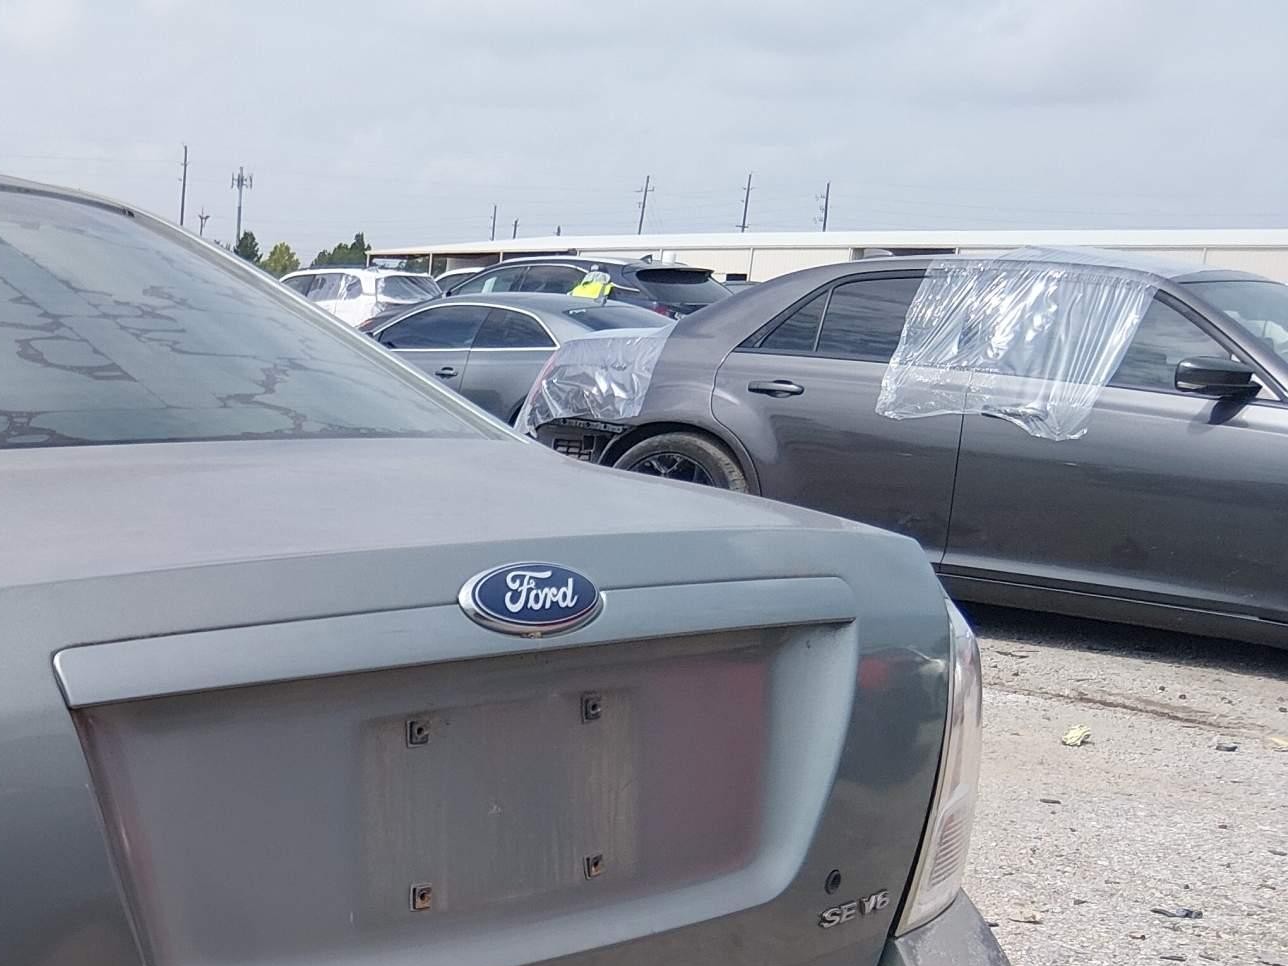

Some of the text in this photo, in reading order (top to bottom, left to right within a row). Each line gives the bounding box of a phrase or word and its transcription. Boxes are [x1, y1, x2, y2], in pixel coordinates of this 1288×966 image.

[504, 570, 578, 613] Ford
[818, 890, 889, 928] SE V6
